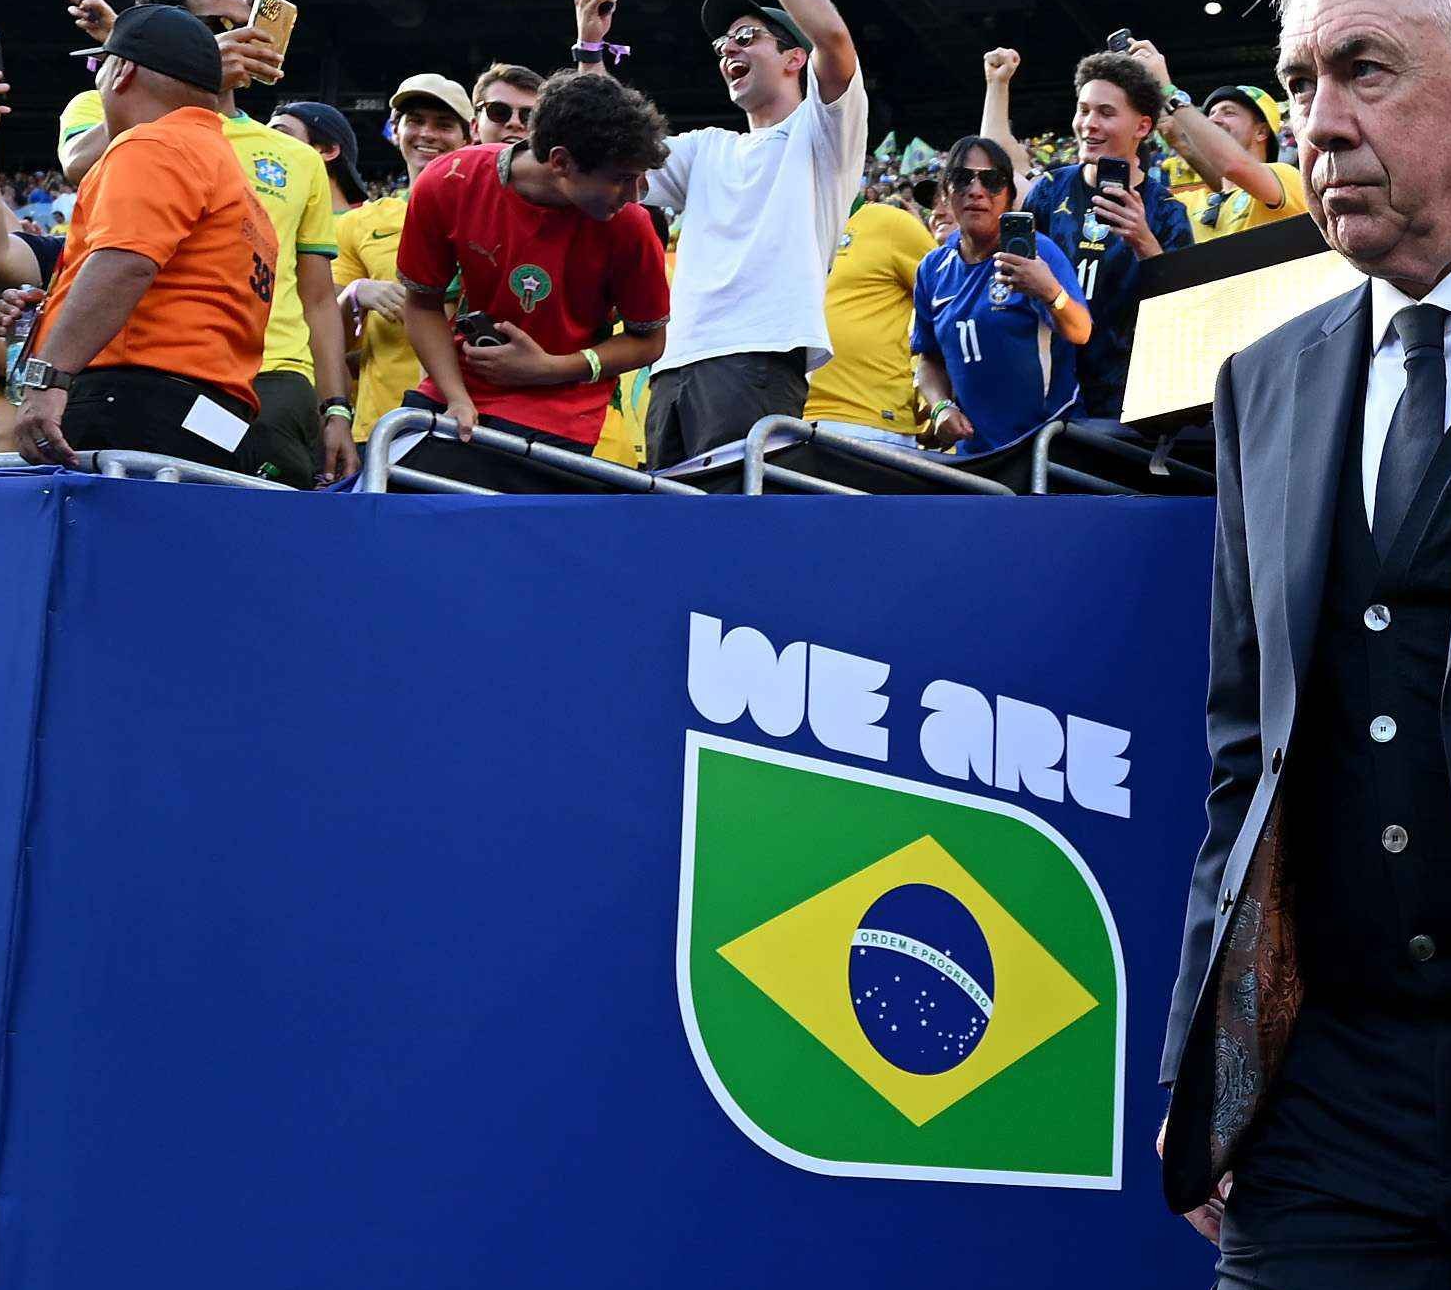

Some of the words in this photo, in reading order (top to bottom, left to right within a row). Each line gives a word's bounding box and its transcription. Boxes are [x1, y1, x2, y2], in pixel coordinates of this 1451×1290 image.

[956, 319, 982, 364] 11
[687, 611, 890, 762] WE
[860, 932, 907, 950] ORDEM
[921, 950, 988, 1008] PROGRESSO
